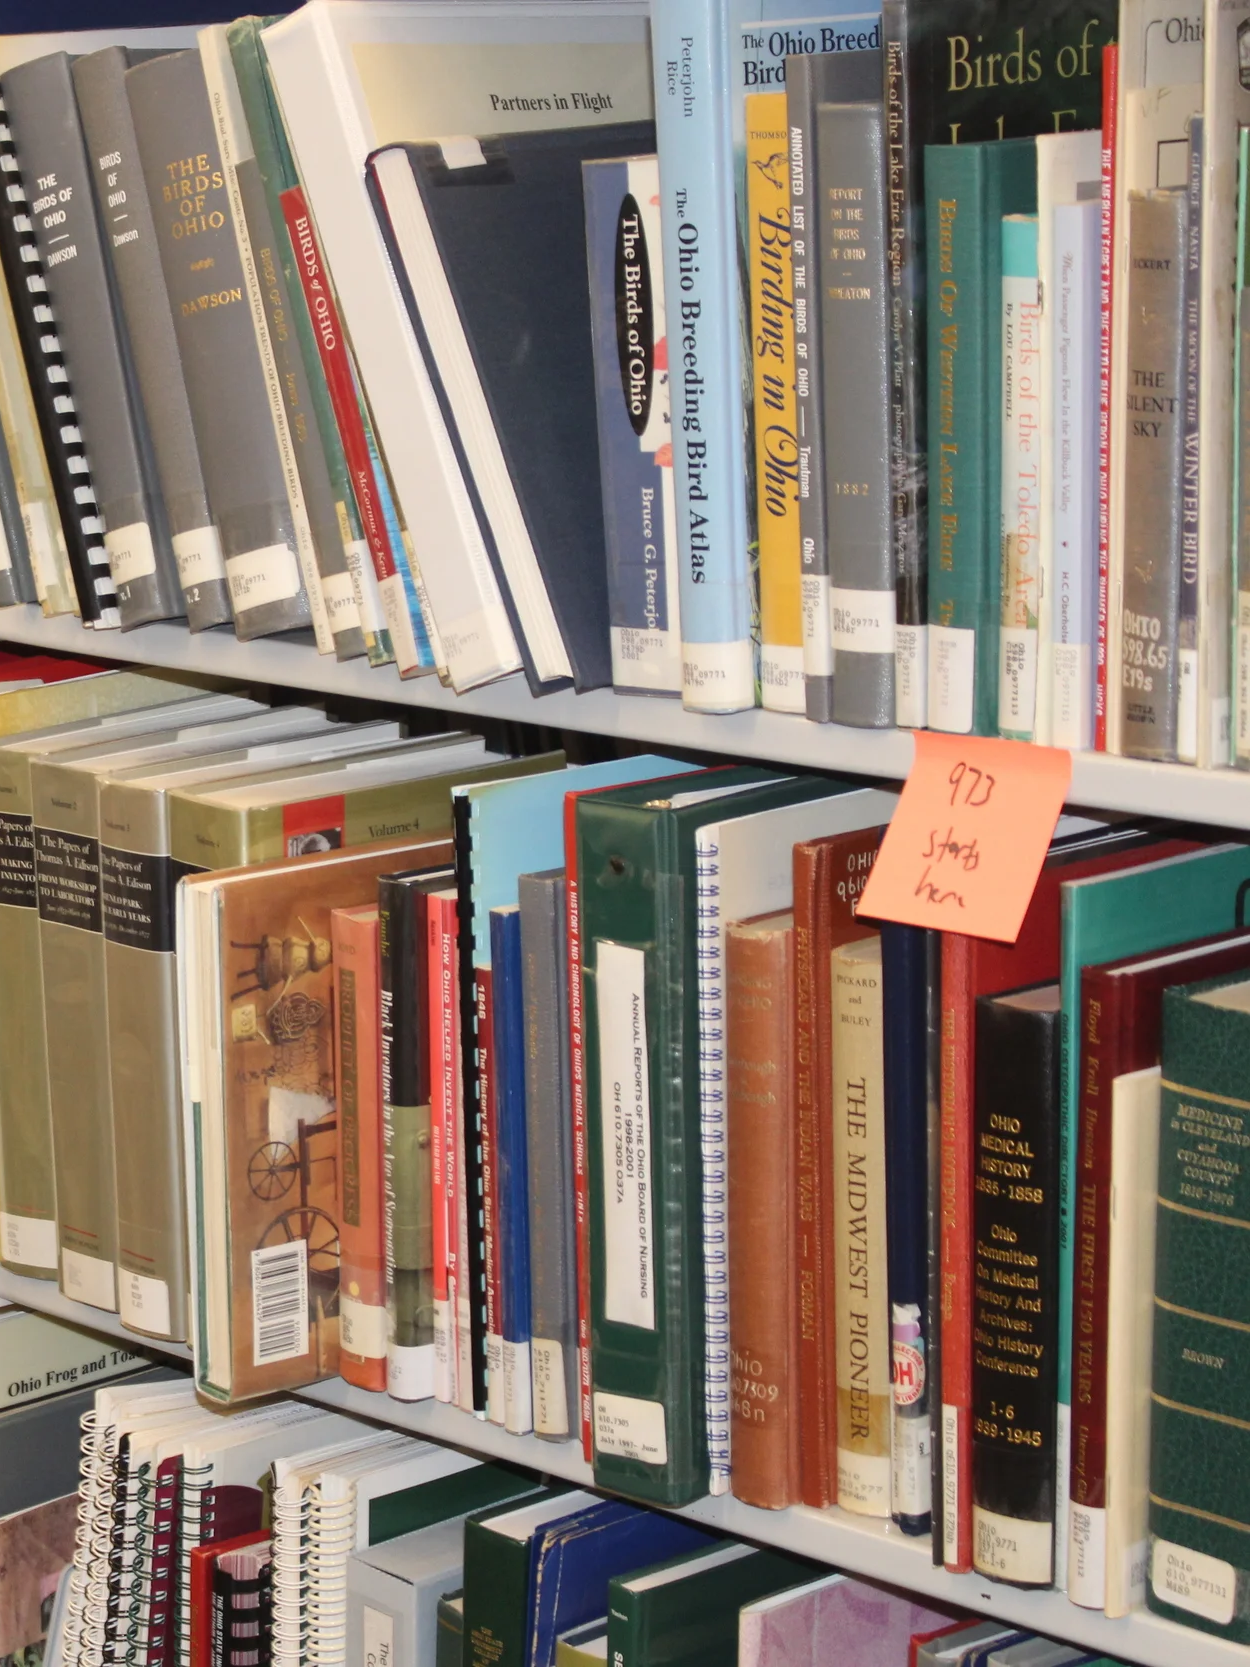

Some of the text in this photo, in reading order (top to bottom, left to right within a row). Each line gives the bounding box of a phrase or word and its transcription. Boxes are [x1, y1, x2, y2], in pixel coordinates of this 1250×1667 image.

[742, 35, 764, 50] The
[769, 30, 816, 56] Ohio
[948, 18, 1098, 93] Birds of
[666, 60, 676, 96] Rice
[680, 36, 694, 118] Peterjohn
[743, 60, 786, 86] Bird
[490, 93, 613, 114] Partners in Flight
[100, 152, 121, 169] BIRDS
[166, 154, 210, 175] THE
[886, 41, 906, 285] Birds of the Lake Erie Region
[38, 174, 57, 190] THE
[108, 173, 118, 186] OF
[163, 173, 224, 202] BIRDS
[33, 188, 73, 214] BIRDS OF
[108, 190, 126, 208] OHIO
[180, 196, 205, 216] OF
[43, 211, 66, 228] OHIO
[172, 212, 225, 239] OHIO
[113, 229, 139, 247] Dawson
[48, 245, 77, 267] DAWSON
[789, 126, 809, 397] ANNOTATED LIST OF THE BIRDS OF OHIO
[294, 215, 337, 351] BIRDS of OHIO
[182, 288, 242, 316] DAWSON
[621, 213, 647, 415] The Birds of Ohio
[749, 206, 802, 518] Birding in Ohio
[1004, 302, 1013, 420] By LOU CAMPBELL
[245, 255, 299, 498] POPULATION TRENDS OF OHIO BREEDING BIRDS
[675, 187, 711, 584] The Ohio Breeding Bird Atlas
[1133, 369, 1166, 387] THE
[1126, 396, 1178, 415] SILENT
[1132, 421, 1164, 438] SKY
[1014, 301, 1040, 626] Birds of the Toledo Area
[640, 487, 656, 538] Bruce
[643, 543, 657, 564] G.
[948, 762, 996, 806] 973
[368, 818, 419, 838] Volume 4
[40, 834, 91, 856] The Papers of
[36, 850, 99, 873] Thomas A. Edison
[837, 974, 877, 988] PICKARD
[849, 996, 862, 1004] and
[841, 1014, 872, 1027] BULEY
[612, 1081, 622, 1100] OH
[613, 1104, 623, 1164] 610.7305
[990, 1113, 1021, 1133] OHIO
[380, 989, 396, 1284] Black Inventors in the Age of Segregation
[624, 1112, 634, 1178] 1998-2001
[631, 993, 648, 1298] ANNUAL REPORTS OF THE OHIO BOARD OF NURSING
[981, 1131, 1034, 1158] MEDICAL
[981, 1156, 1032, 1179] HISTORY
[991, 1224, 1018, 1243] Ohio
[845, 1077, 870, 1439] THE MIDWEST PIONEER
[977, 1242, 1038, 1267] Committee
[976, 1261, 1040, 1291] On Medical
[976, 1284, 1042, 1313] History And
[1078, 1184, 1095, 1404] THE FIRST 150 YEARS
[979, 1310, 1034, 1335] Archives:
[975, 1328, 1044, 1358] Ohio History
[8, 1378, 42, 1398] Ohio
[46, 1366, 78, 1386] Frog
[82, 1355, 106, 1375] and
[976, 1351, 1039, 1378] Conference
